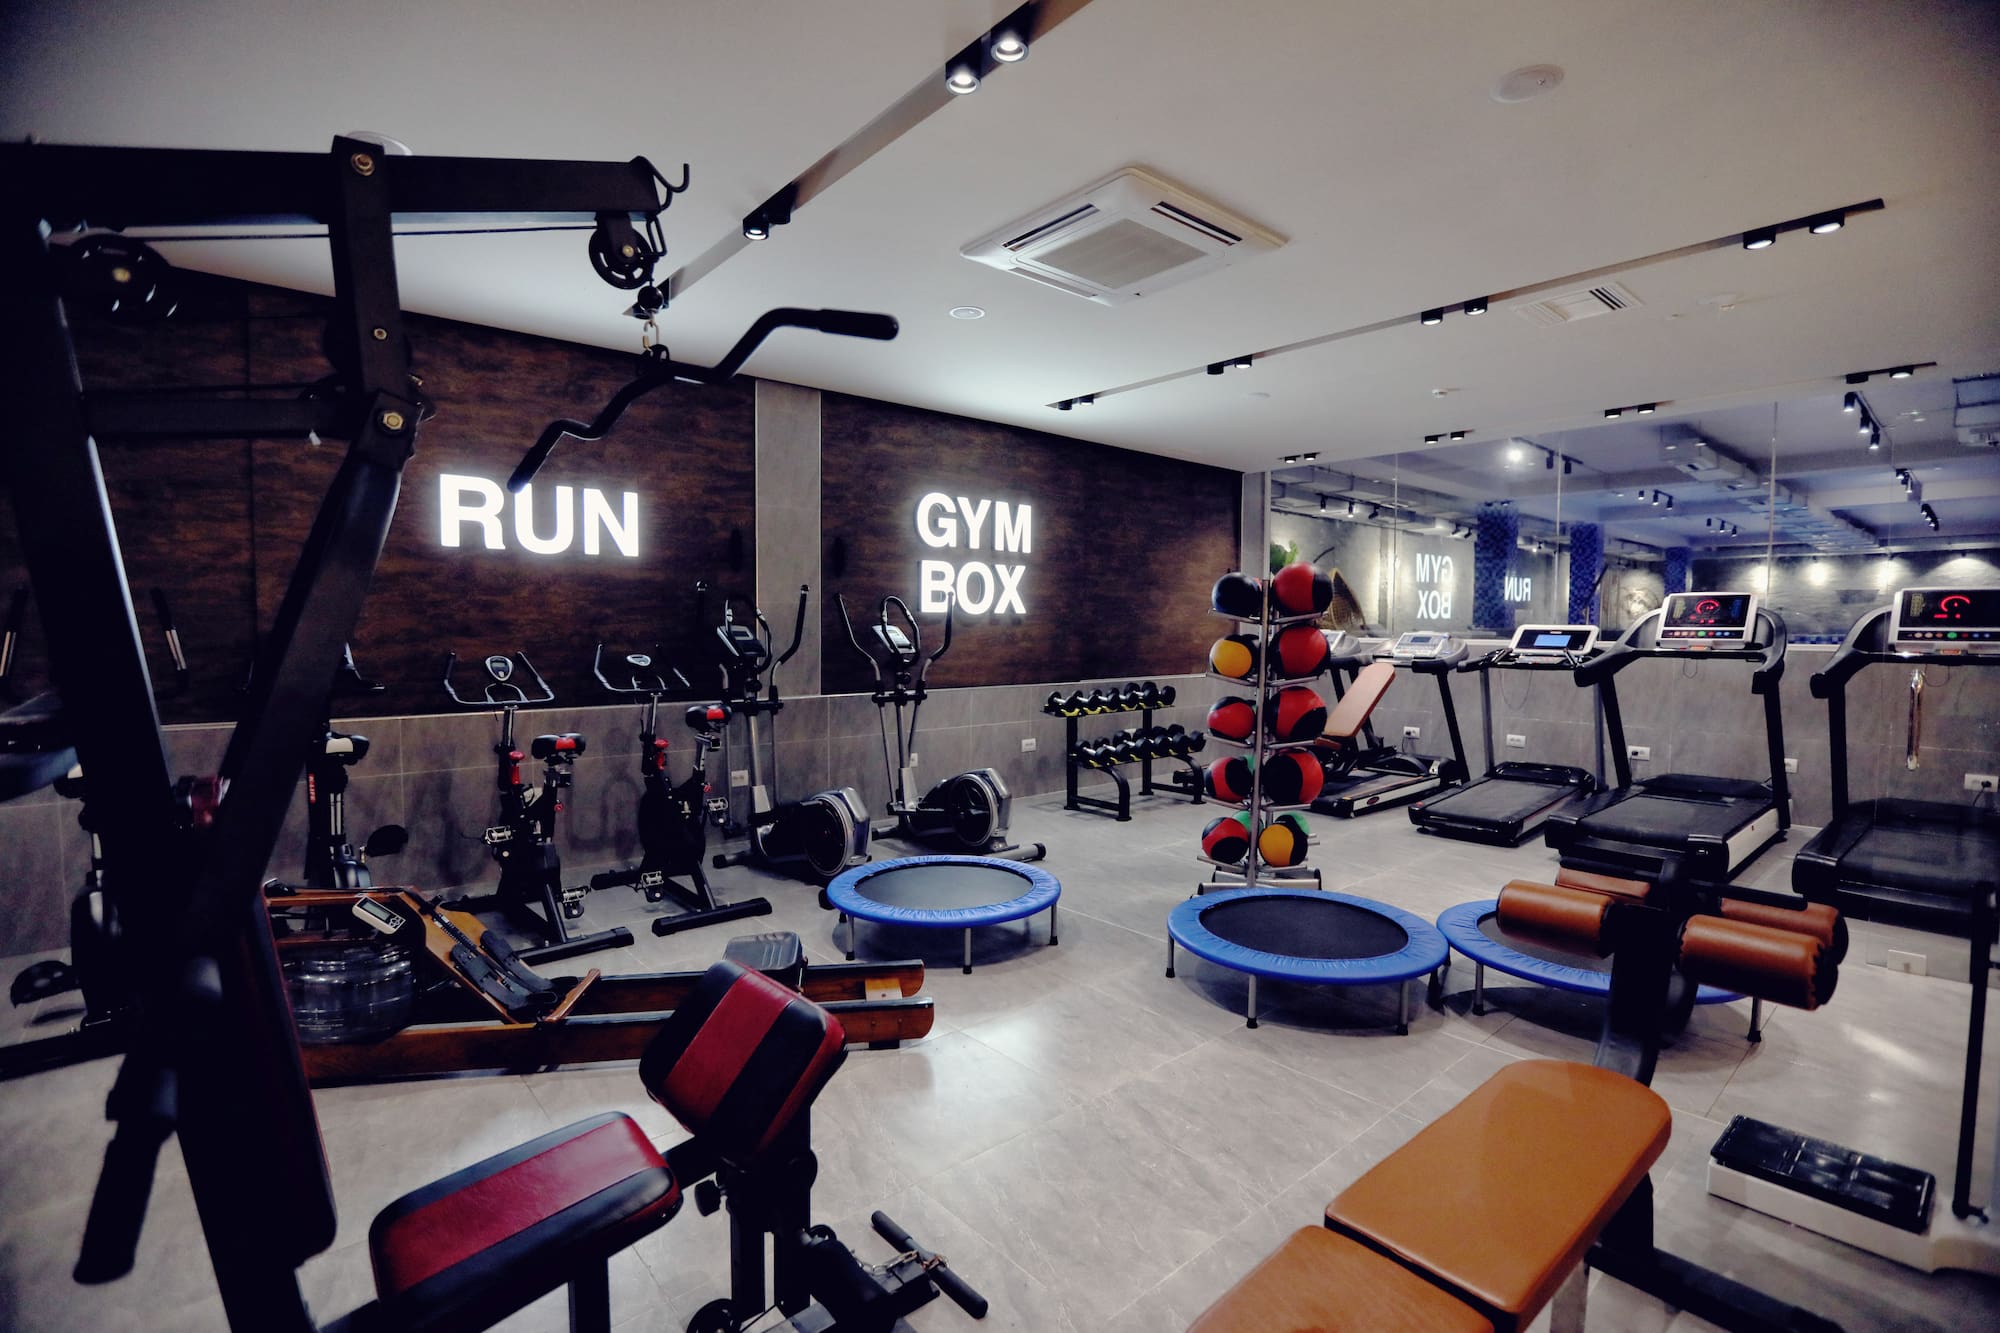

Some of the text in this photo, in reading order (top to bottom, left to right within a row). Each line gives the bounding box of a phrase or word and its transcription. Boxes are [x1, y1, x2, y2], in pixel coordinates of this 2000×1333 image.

[440, 474, 639, 557] RUN
[917, 492, 1032, 553] GYM
[920, 559, 1026, 614] BOX
